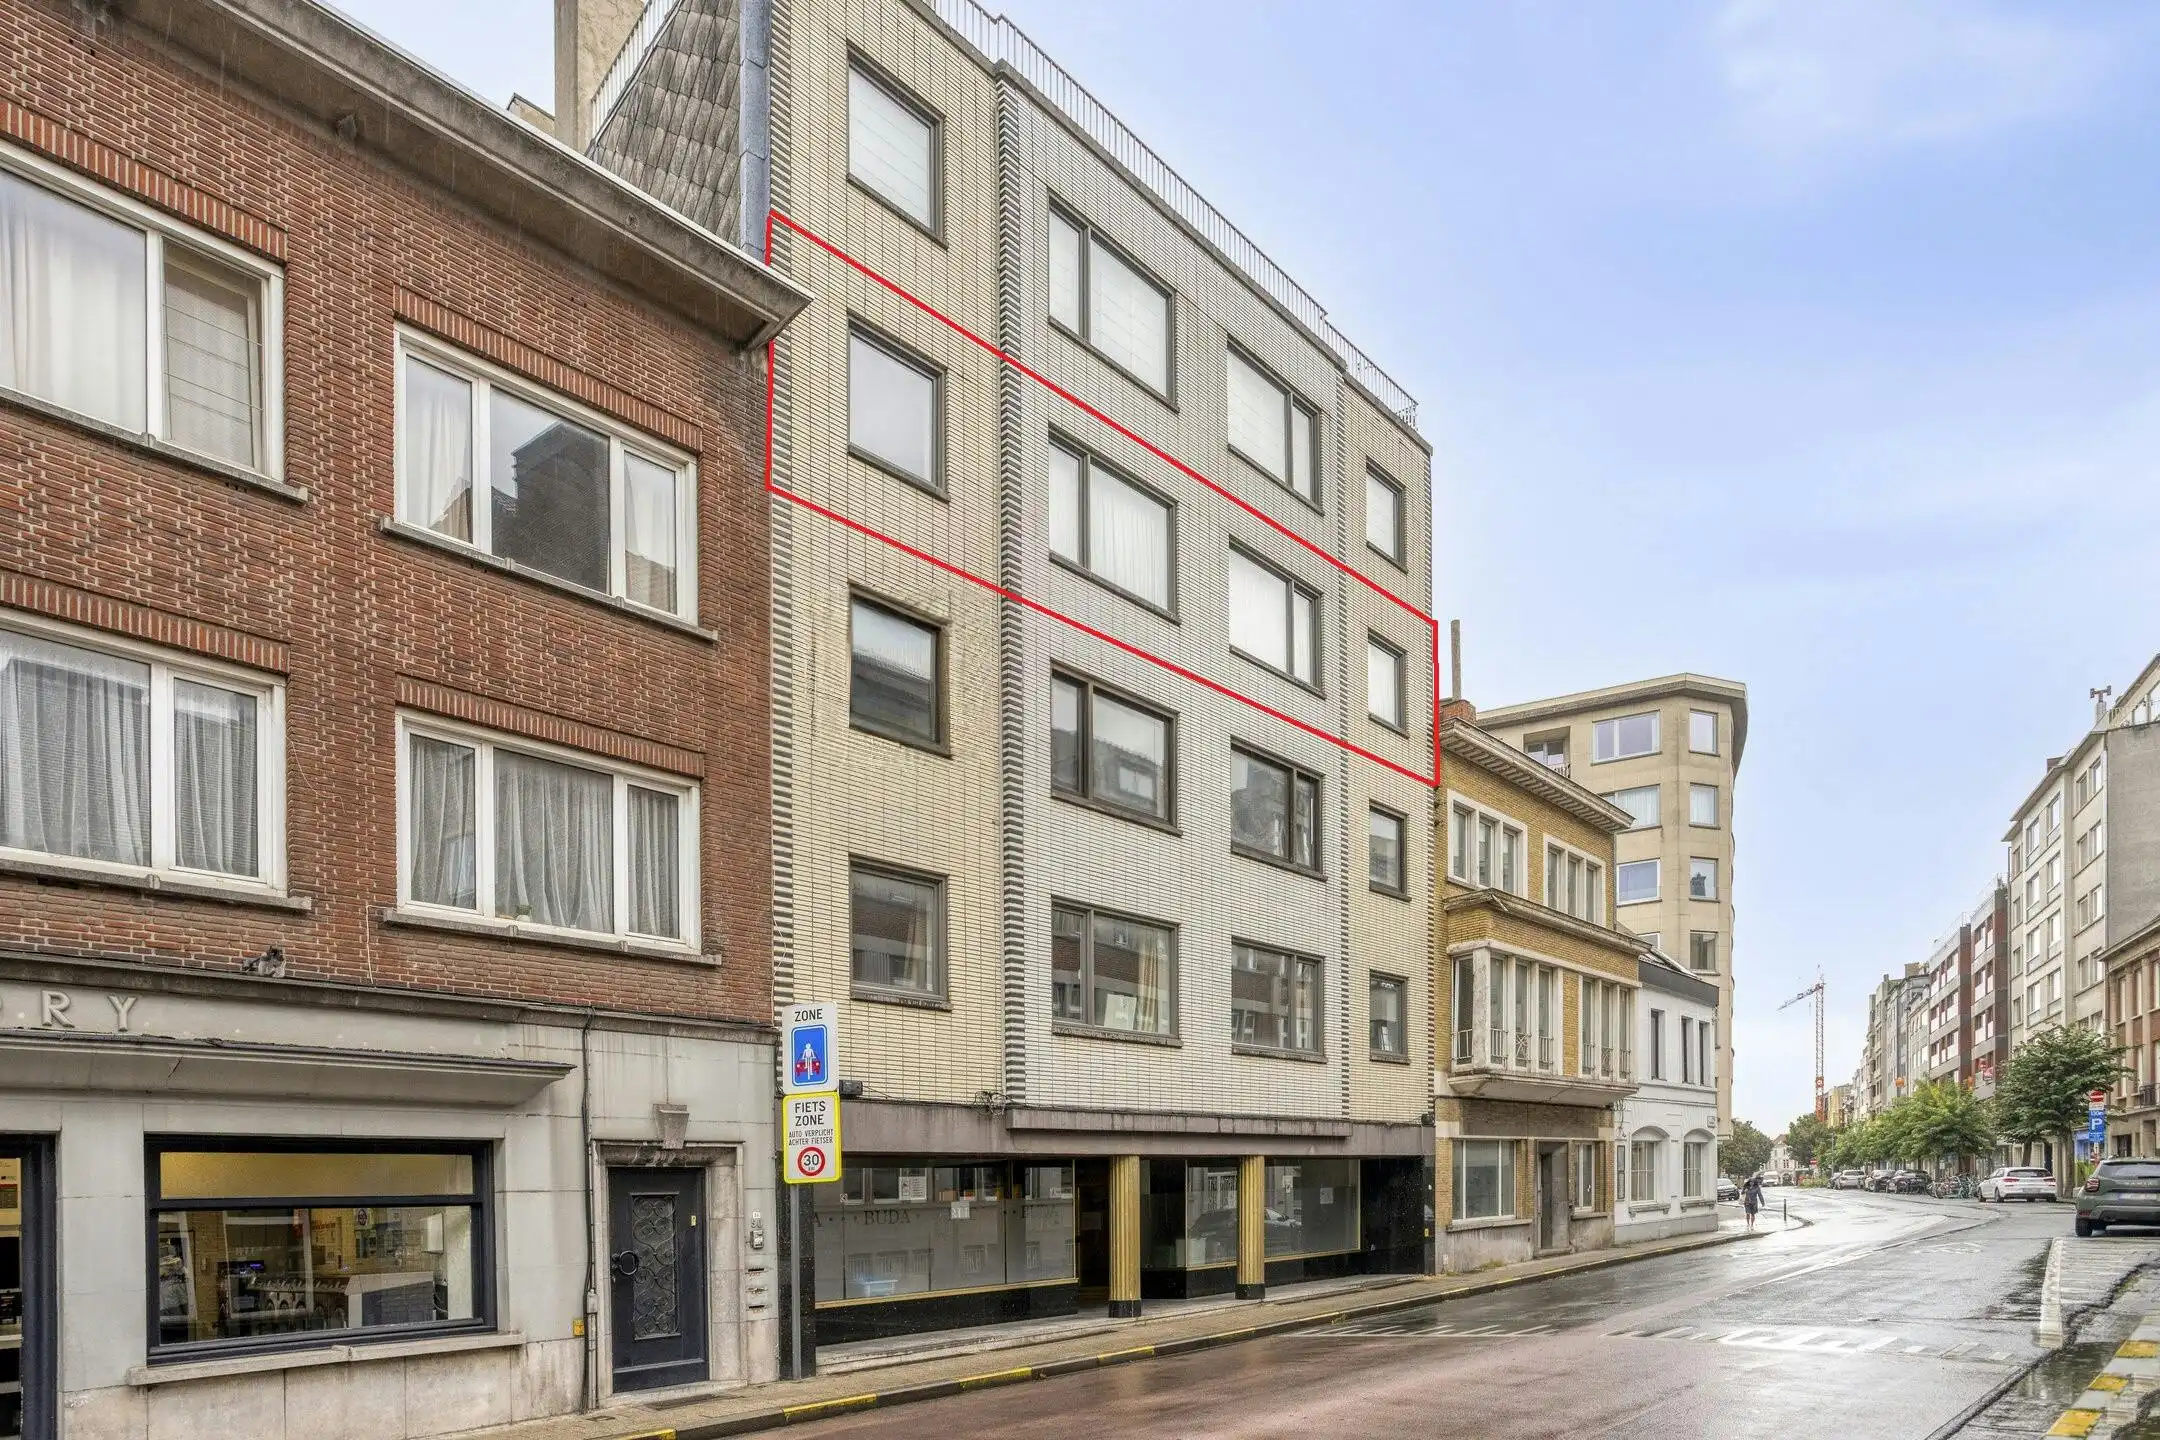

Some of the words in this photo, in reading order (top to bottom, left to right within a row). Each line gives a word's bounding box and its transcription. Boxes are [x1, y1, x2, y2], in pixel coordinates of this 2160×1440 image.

[0, 989, 137, 1032] RY
[795, 1008, 823, 1022] ZONE
[795, 1100, 826, 1113] FIETS
[795, 1114, 824, 1126] ZONE
[2092, 1118, 2103, 1130] P
[789, 1130, 802, 1138] AUTO
[805, 1128, 833, 1137] VERPLICHT
[789, 1138, 809, 1146] ACHTER
[811, 1136, 833, 1145] FIETSER
[803, 1154, 819, 1166] 30
